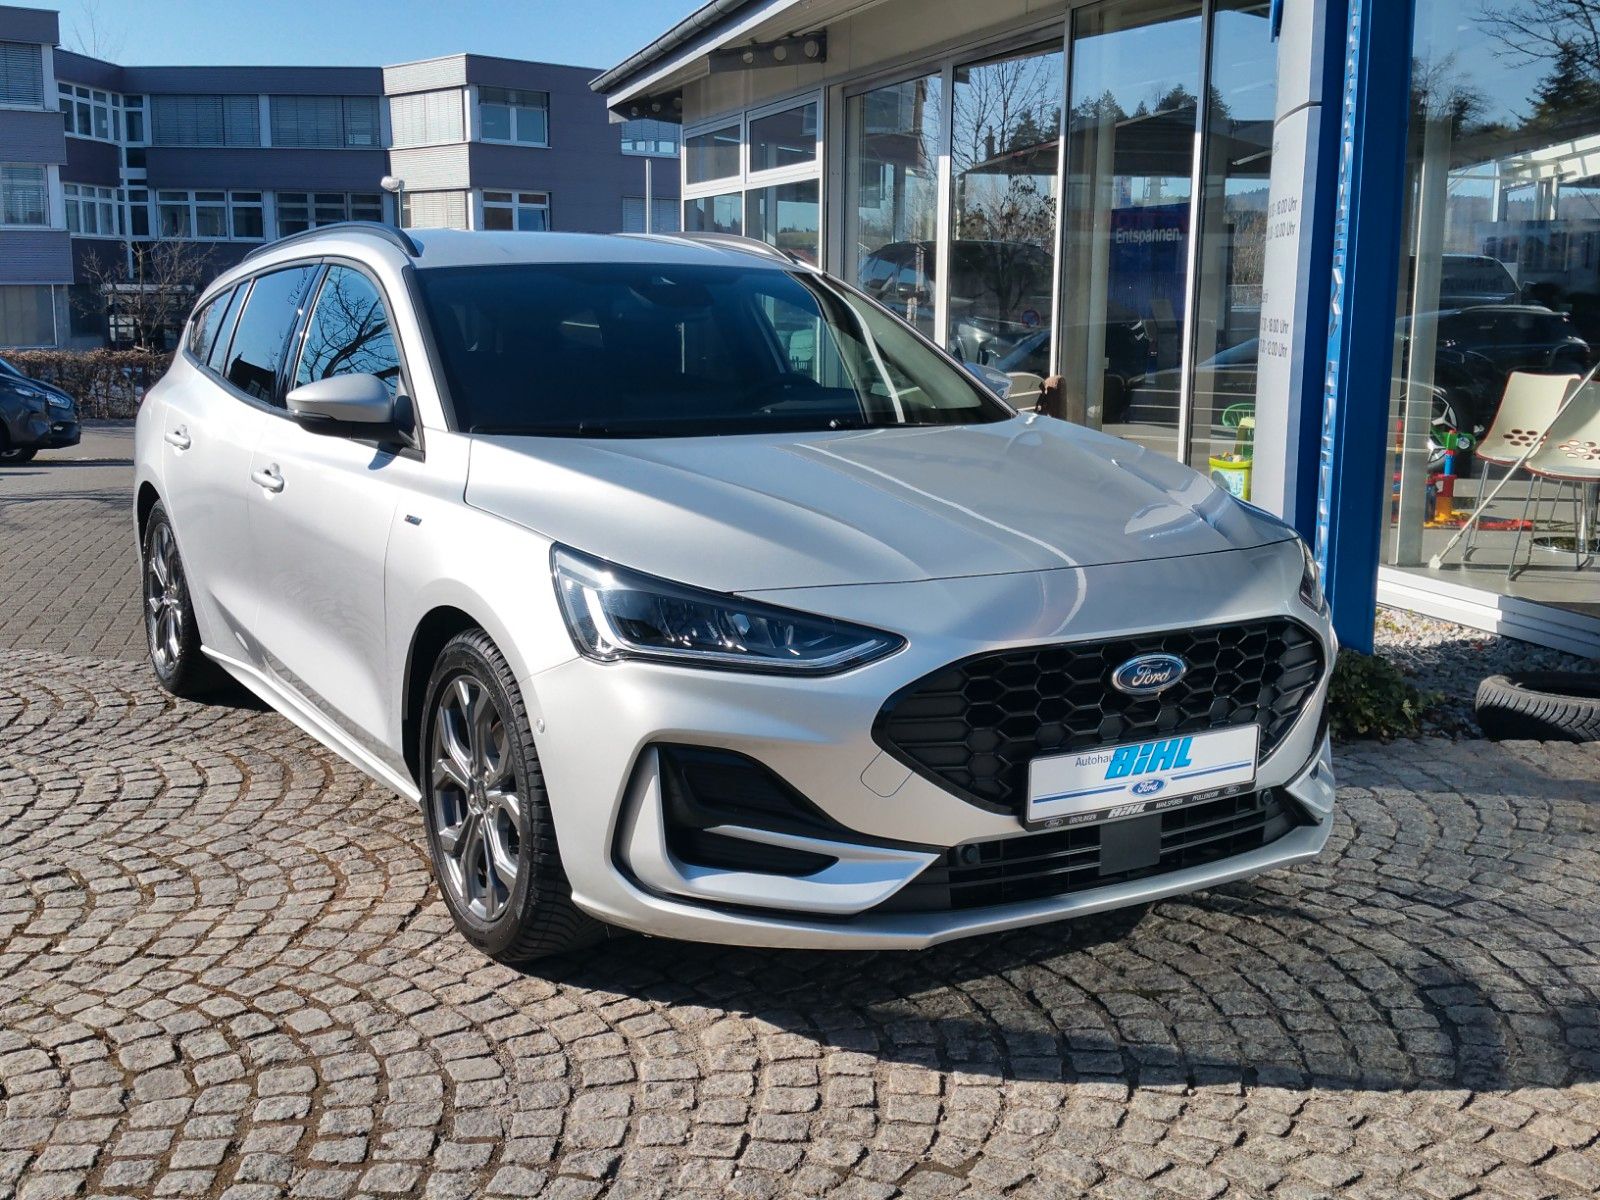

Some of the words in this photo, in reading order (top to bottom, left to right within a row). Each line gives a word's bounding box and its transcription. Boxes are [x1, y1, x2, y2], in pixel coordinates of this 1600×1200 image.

[1115, 227, 1183, 246] Entspannen.
[1131, 662, 1172, 686] Ford
[1137, 780, 1159, 793] Ford
